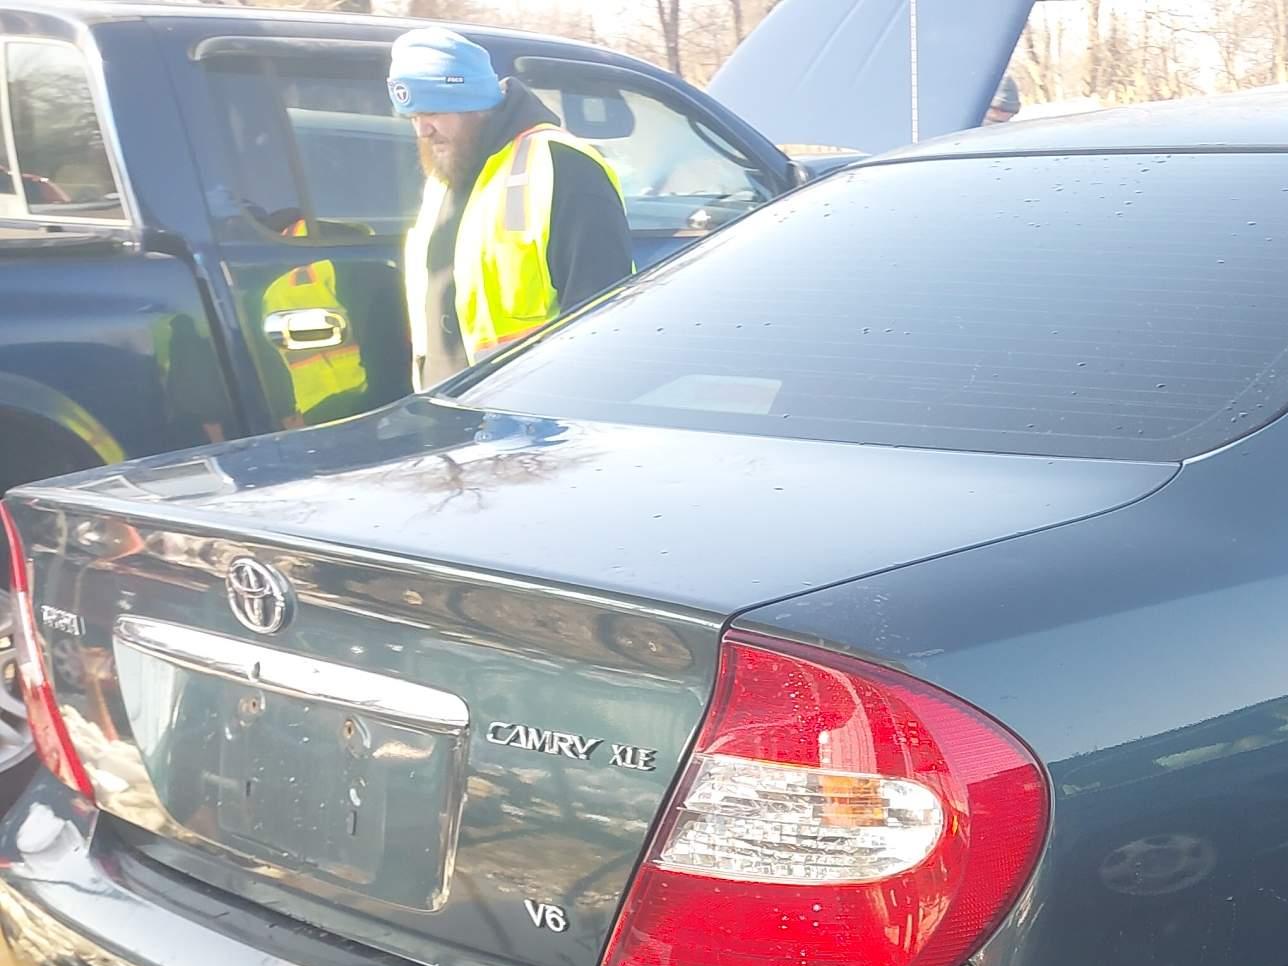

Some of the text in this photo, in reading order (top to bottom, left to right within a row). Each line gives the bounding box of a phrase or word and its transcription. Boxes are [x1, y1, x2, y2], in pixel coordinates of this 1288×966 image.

[486, 721, 657, 771] CAMRY XLE
[523, 899, 568, 932] V6
